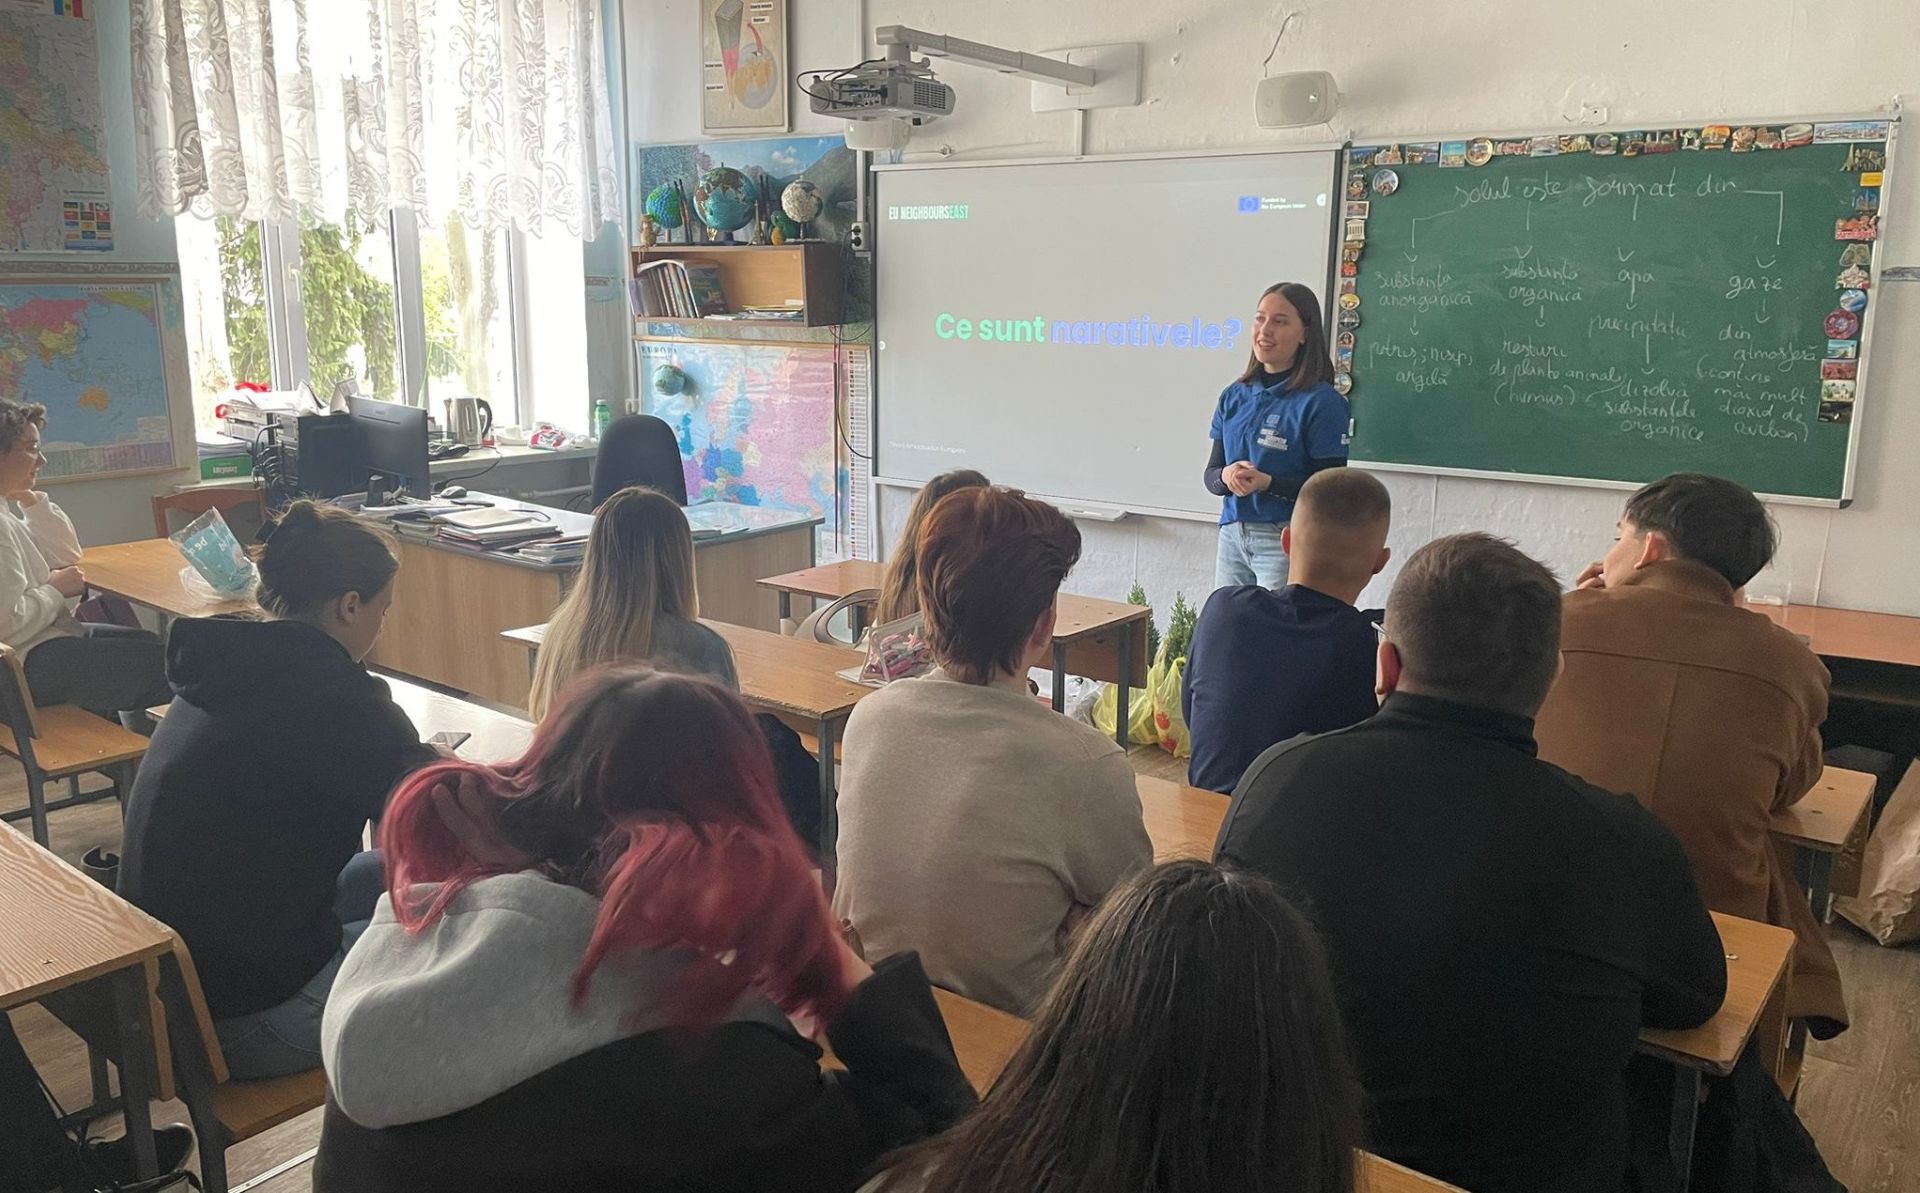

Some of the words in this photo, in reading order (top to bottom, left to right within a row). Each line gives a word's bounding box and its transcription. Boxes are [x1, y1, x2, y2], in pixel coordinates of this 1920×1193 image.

[1455, 176, 1511, 207] solul
[1523, 170, 1562, 201] este
[1696, 174, 1737, 198] din
[889, 206, 899, 220] EU
[1725, 275, 1783, 299] gaze
[935, 312, 973, 341] Ce
[979, 315, 1046, 343] sunt
[1051, 314, 1242, 349] narativele?
[1718, 324, 1751, 341] din
